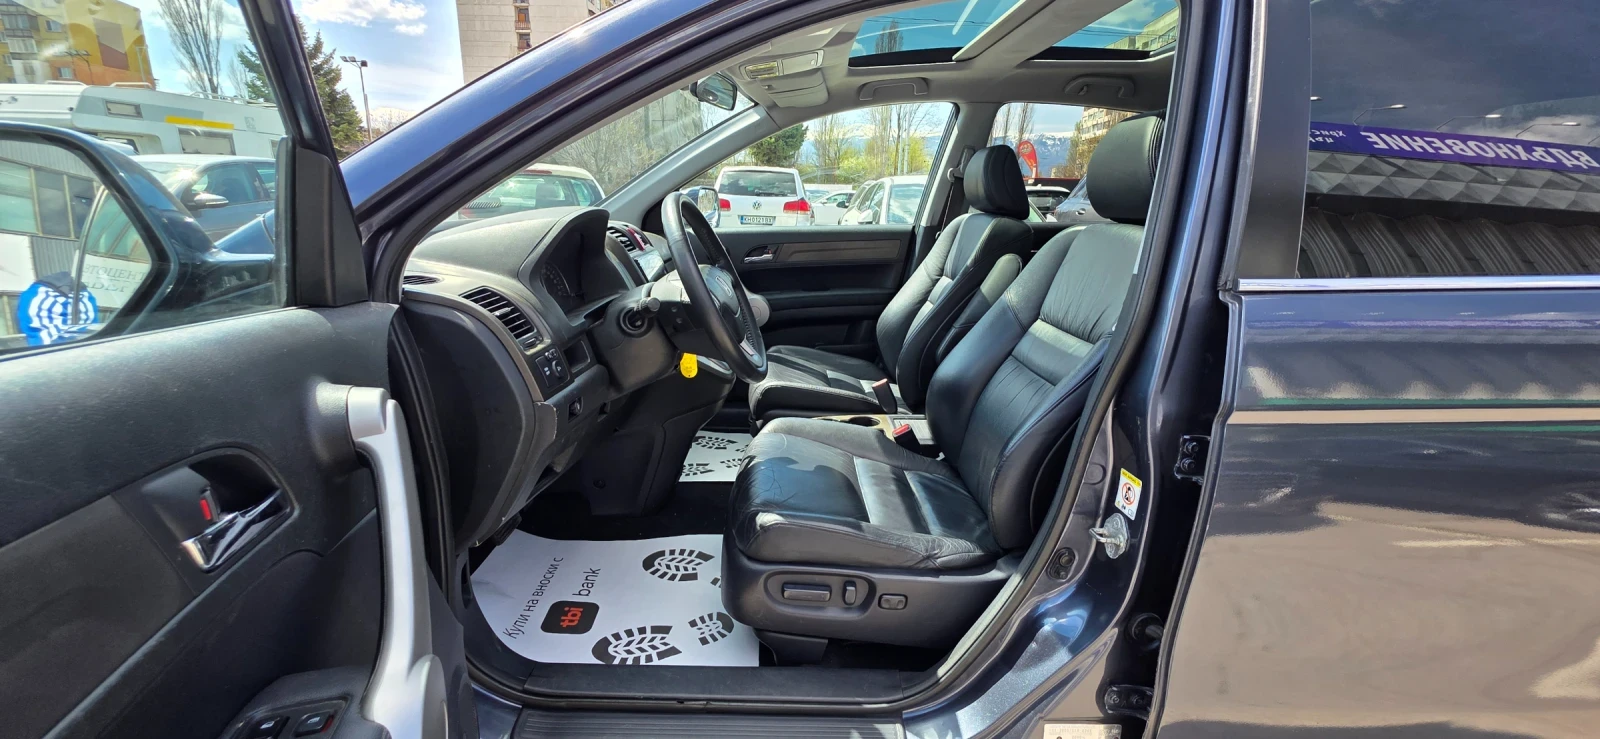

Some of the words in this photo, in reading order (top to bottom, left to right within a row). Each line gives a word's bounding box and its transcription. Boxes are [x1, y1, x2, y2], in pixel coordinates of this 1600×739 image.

[502, 613, 531, 639] Купи
[523, 599, 540, 612] на
[532, 563, 560, 597] вноски
[560, 606, 584, 628] tbi
[572, 567, 602, 597] bank
